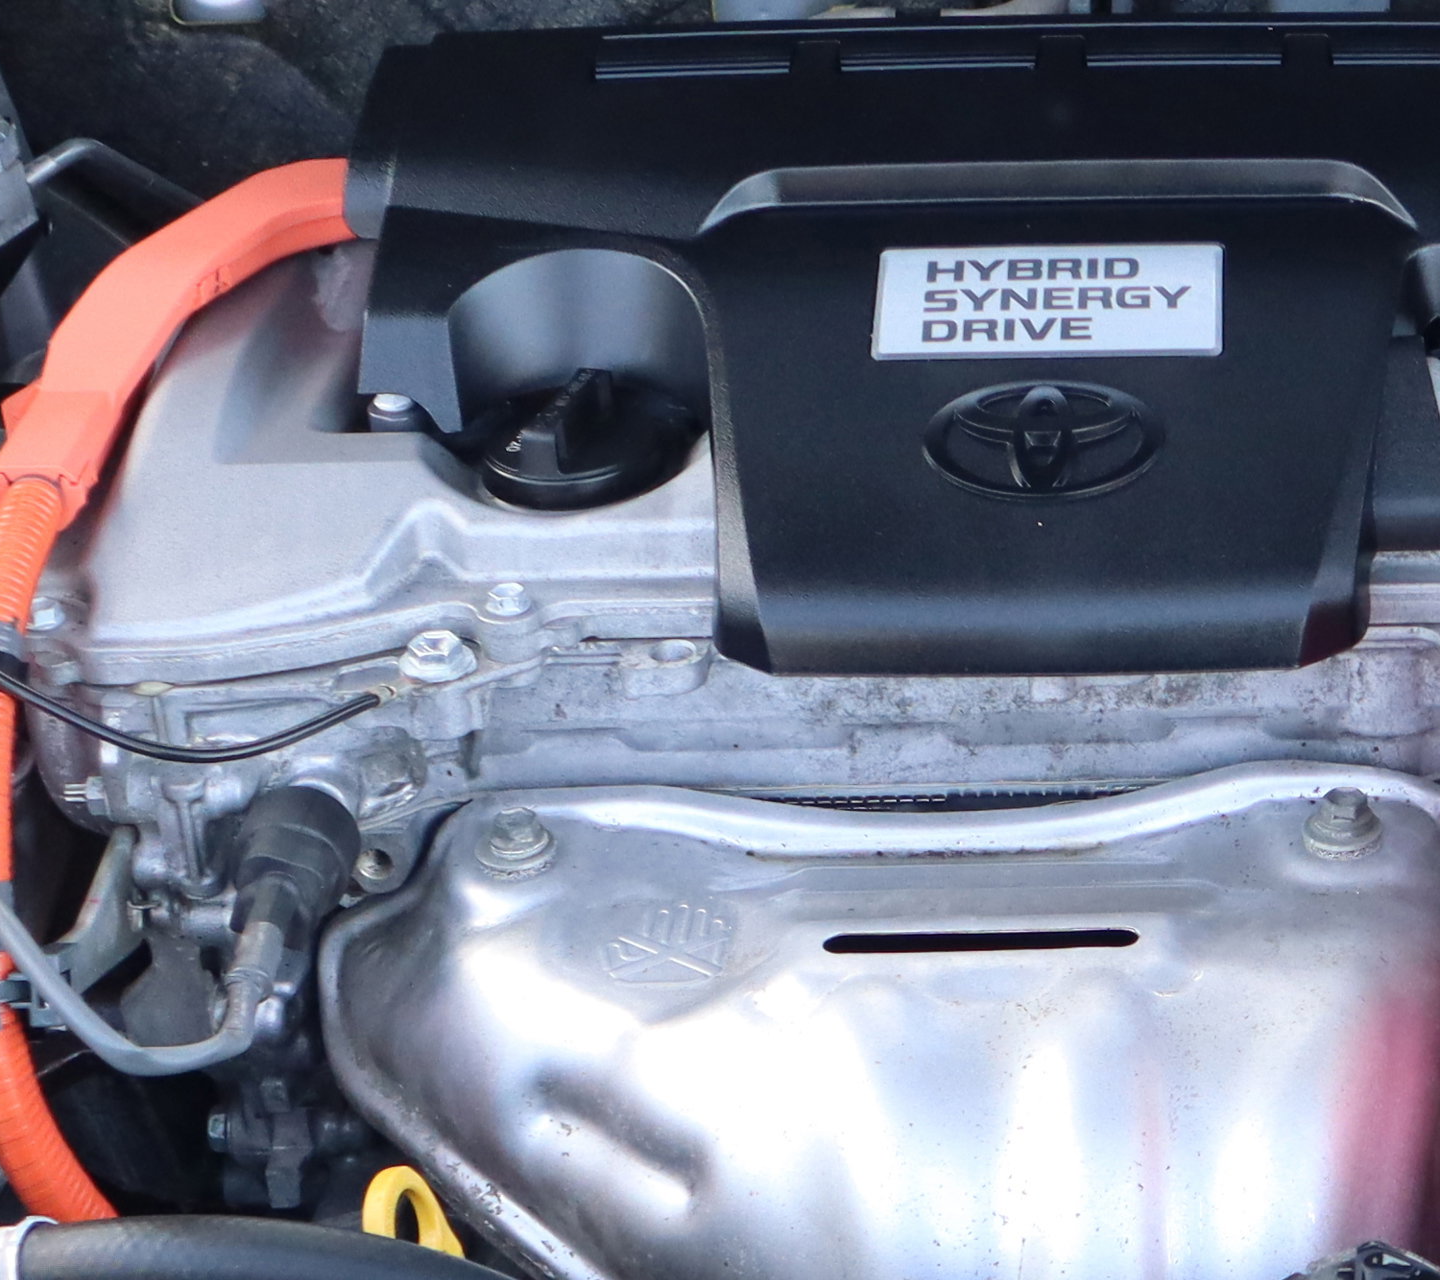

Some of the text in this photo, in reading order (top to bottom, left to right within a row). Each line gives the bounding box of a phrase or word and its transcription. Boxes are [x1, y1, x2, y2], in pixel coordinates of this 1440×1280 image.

[926, 257, 1140, 283] HYBRID
[923, 285, 1192, 313] SYNERGY
[921, 317, 1093, 343] DRIVE
